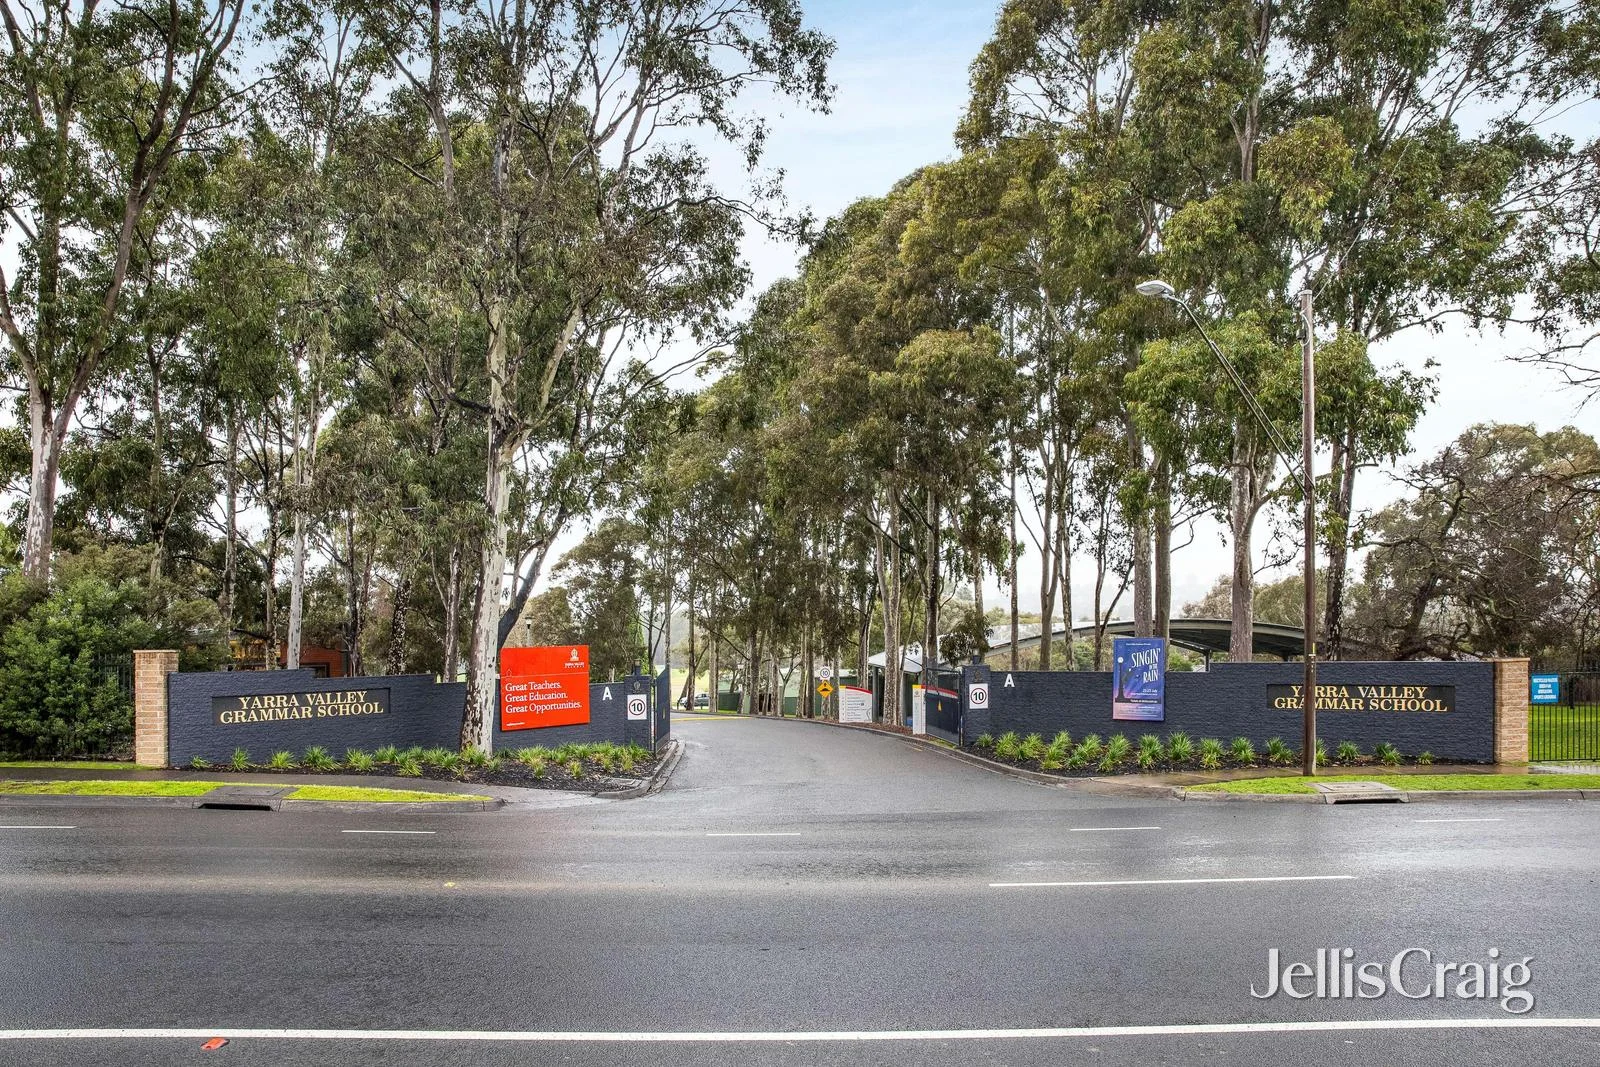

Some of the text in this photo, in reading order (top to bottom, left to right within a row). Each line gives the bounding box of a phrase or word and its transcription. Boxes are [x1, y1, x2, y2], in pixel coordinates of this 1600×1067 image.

[1131, 648, 1161, 668] SINGIN'
[1004, 674, 1015, 688] A
[1143, 670, 1158, 683] RAIN
[505, 680, 562, 692] Great Teachers.
[1291, 686, 1428, 699] YRRA VALLEY
[238, 691, 368, 710] YARRA VALLEY
[505, 691, 568, 703] Great Education.
[602, 686, 612, 701] A
[973, 692, 984, 701] 10
[505, 700, 582, 714] Great Opportunities.
[631, 702, 643, 712] 10
[1369, 698, 1448, 712] SCHOOL
[220, 702, 384, 724] GRAMMAR SCHOOL
